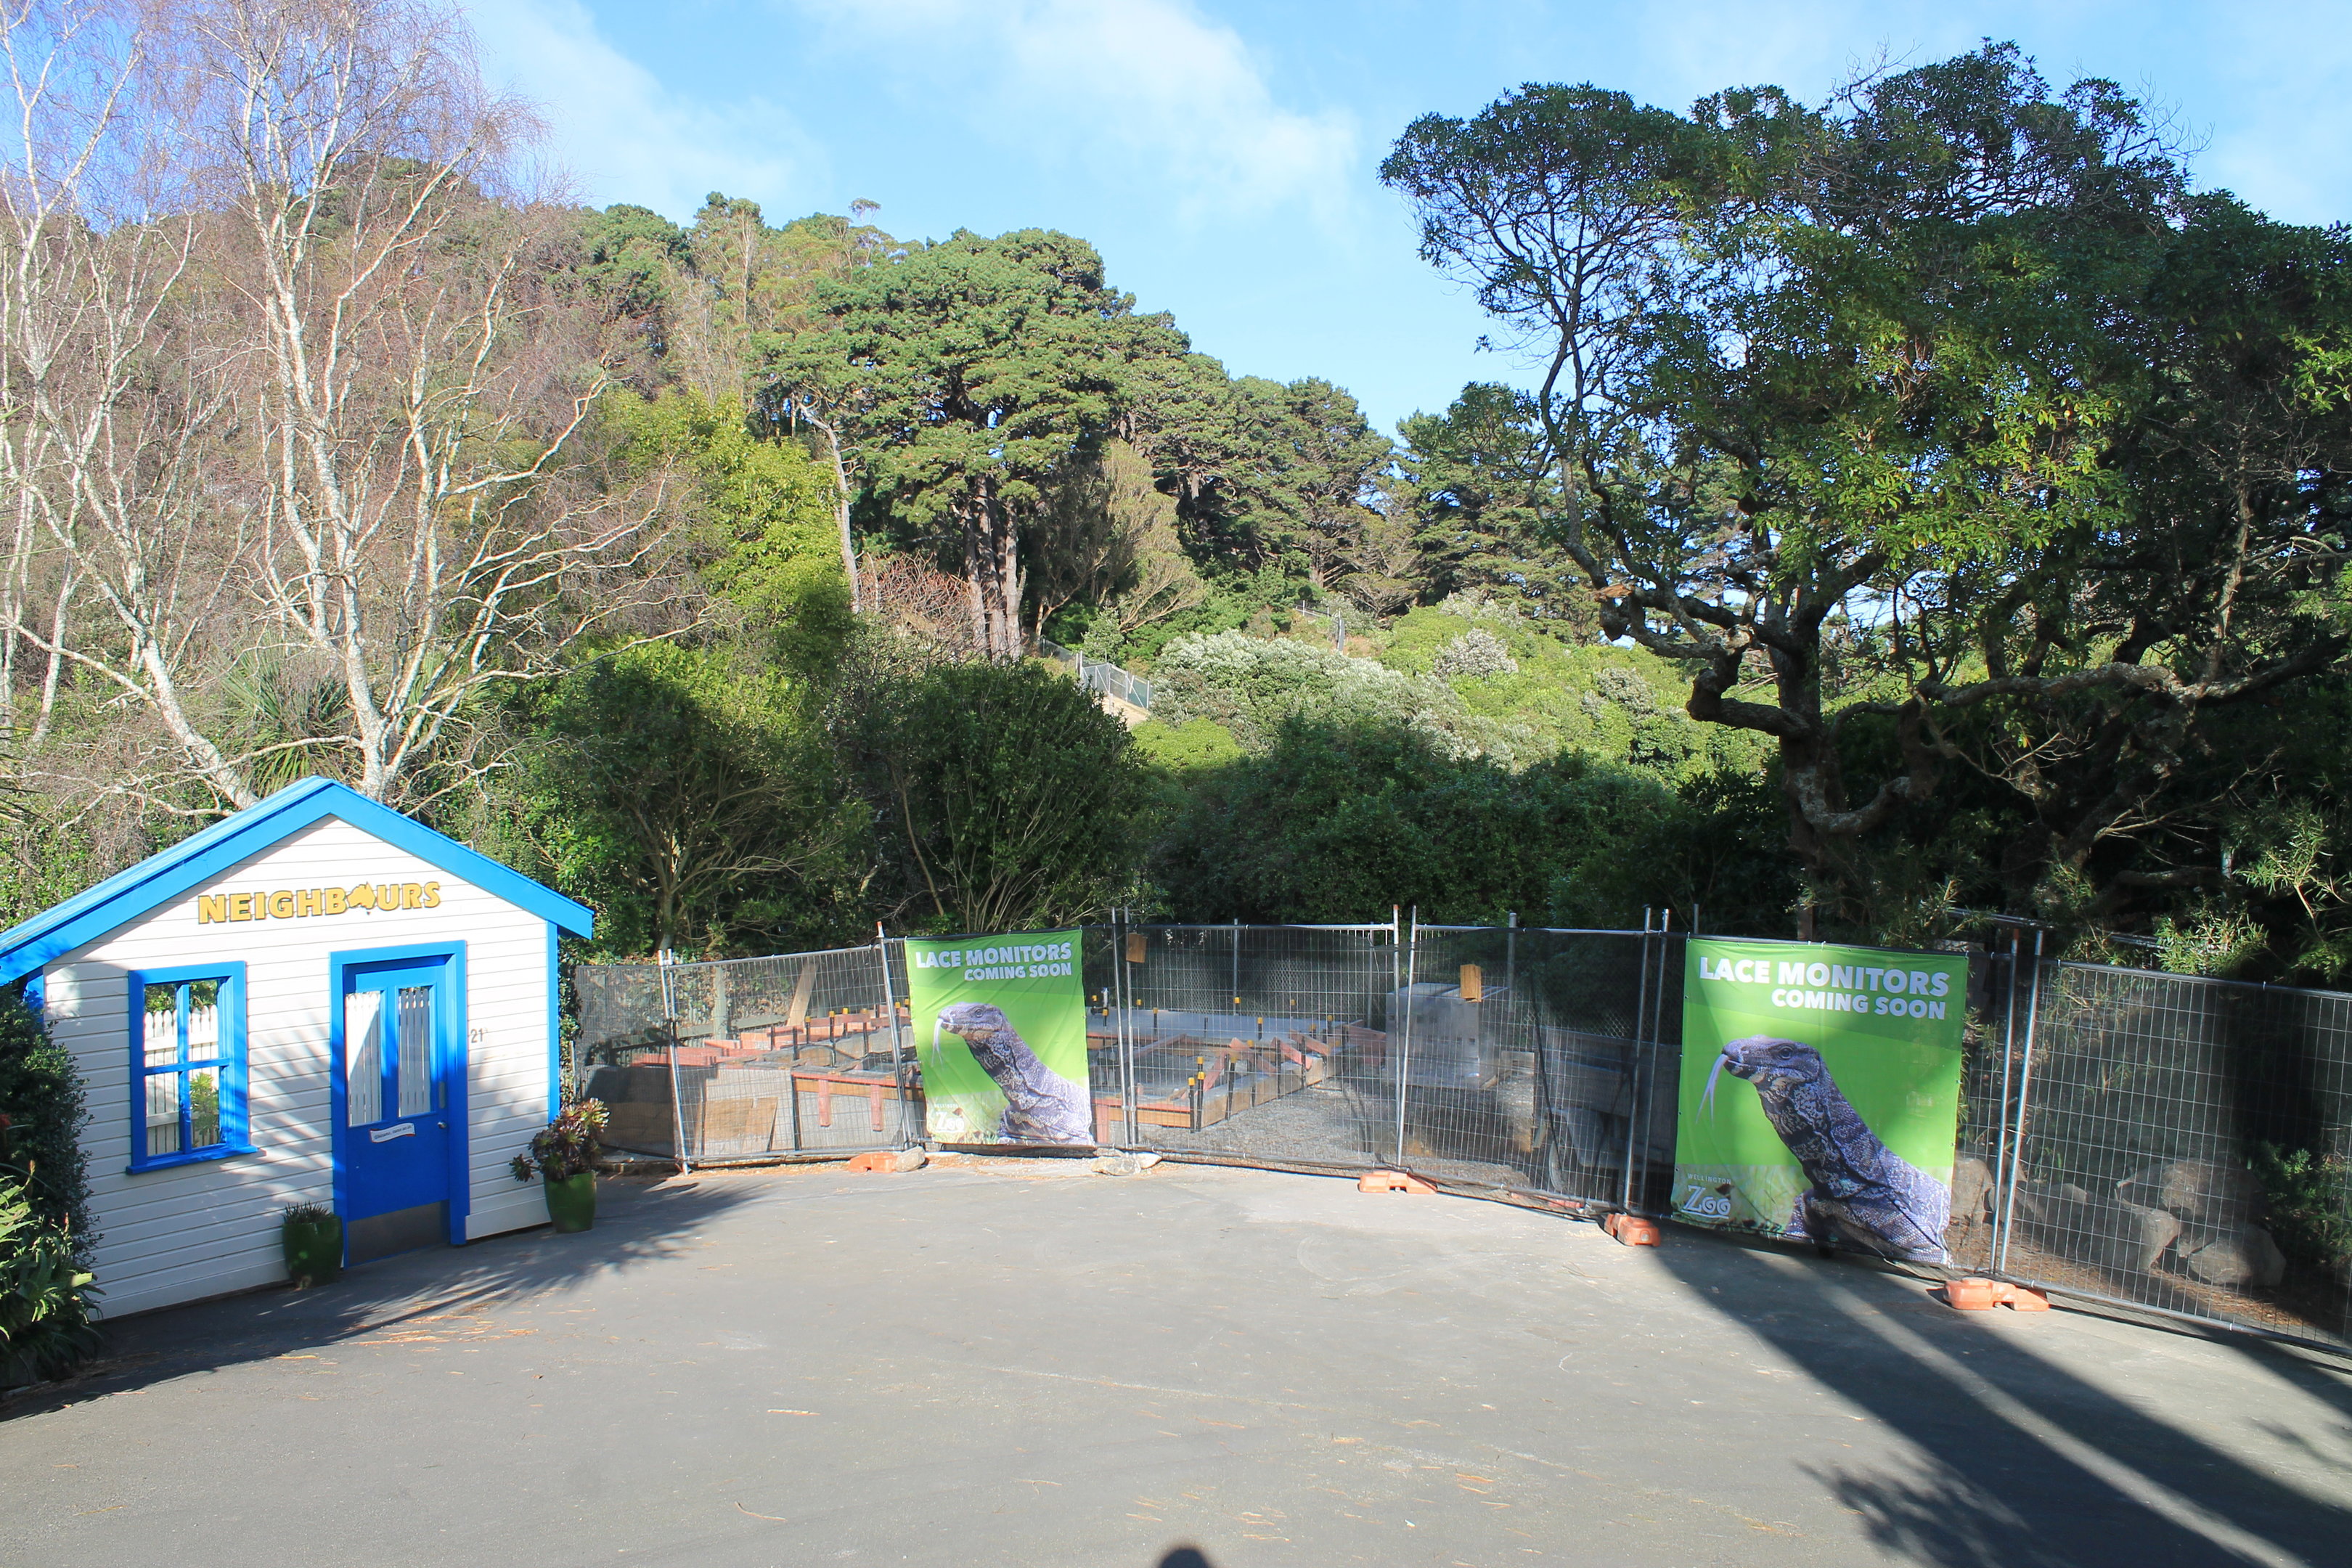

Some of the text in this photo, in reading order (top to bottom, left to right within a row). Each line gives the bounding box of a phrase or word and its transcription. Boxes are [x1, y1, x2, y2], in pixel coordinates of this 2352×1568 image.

[915, 942, 1072, 968] LACE MONITORS
[964, 963, 1072, 981] COMING SOON
[1699, 956, 1950, 997] LACE MONITORS
[1771, 988, 1946, 1020] COMING SOON
[470, 1028, 483, 1043] 21
[1687, 1173, 1731, 1185] WELLINGTON
[1683, 1184, 1731, 1216] Zoo
